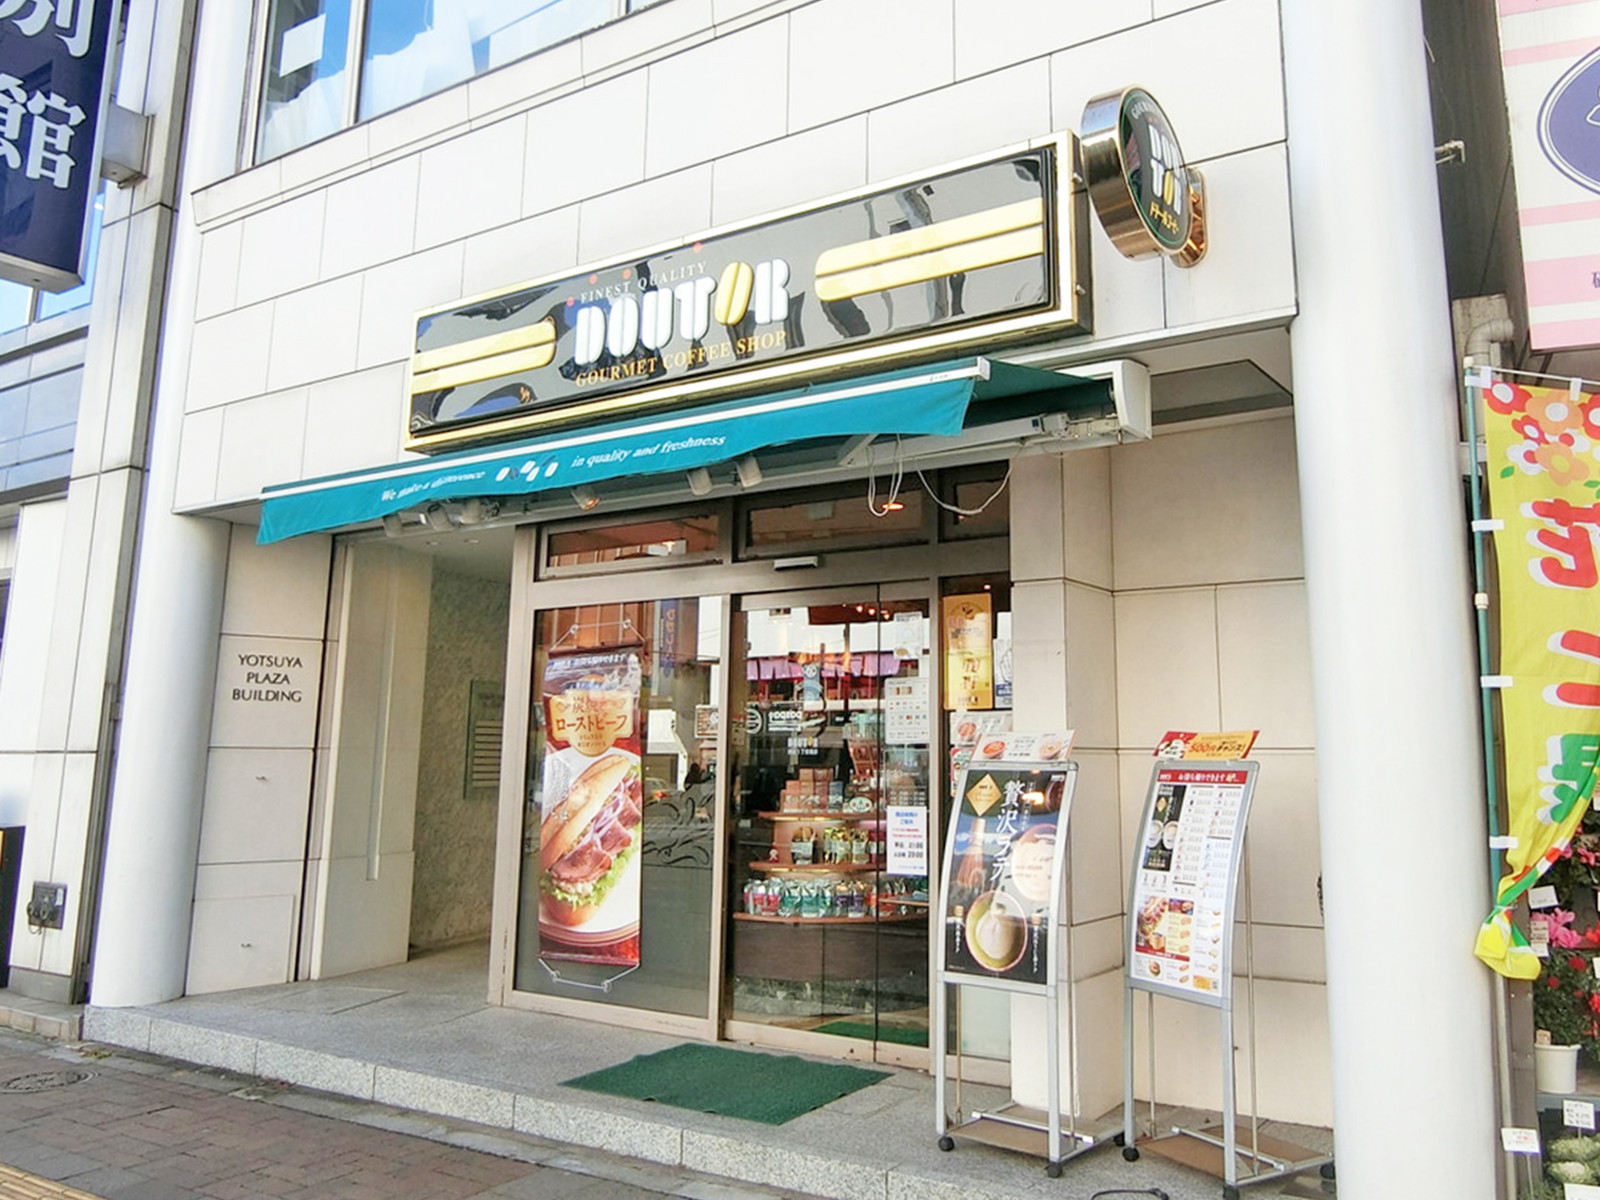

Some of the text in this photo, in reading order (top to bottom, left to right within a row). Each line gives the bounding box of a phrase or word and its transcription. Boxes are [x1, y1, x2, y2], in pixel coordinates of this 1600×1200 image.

[581, 261, 707, 304] FINEST QUALITY
[574, 258, 790, 366] DOUTOR
[575, 330, 787, 387] GOURMET COFFEE SHOP
[571, 436, 727, 468] in quality and freshness
[238, 654, 303, 668] YOTSUYA
[246, 671, 291, 684] PLAZA
[232, 688, 303, 703] BUILDING
[555, 714, 628, 732] ローストビーフ
